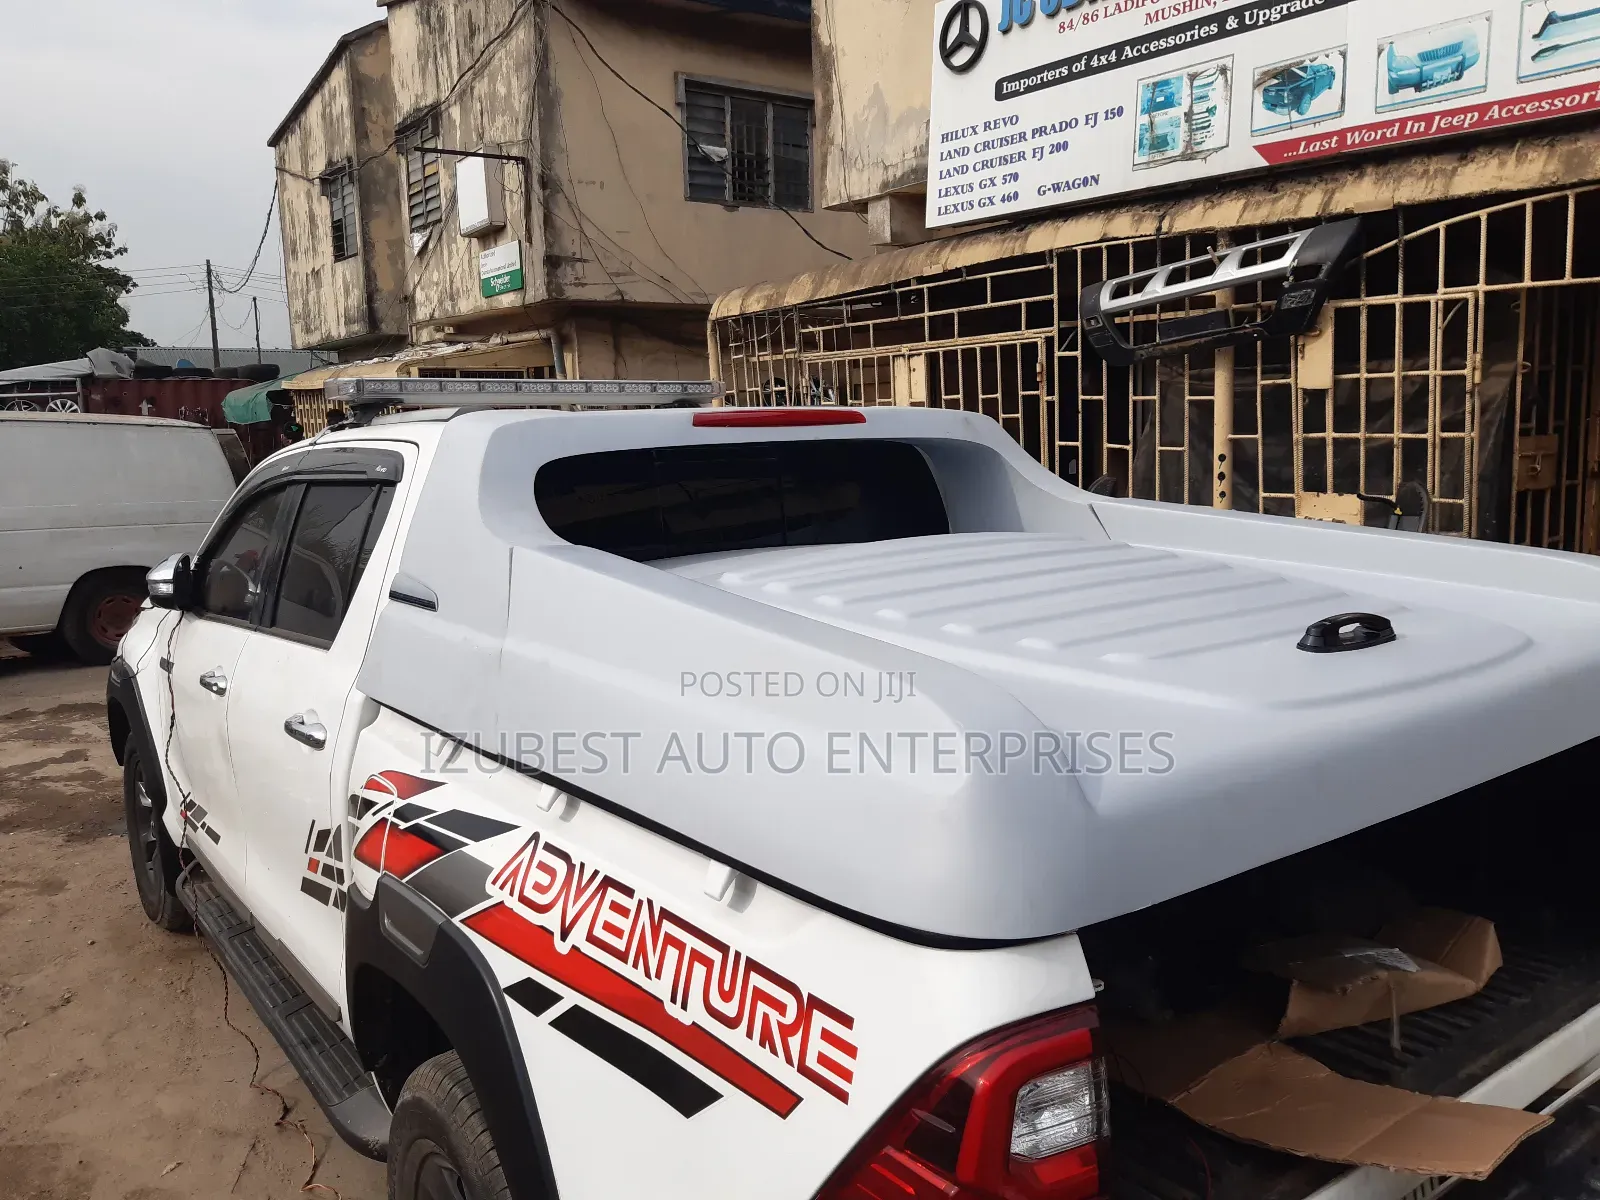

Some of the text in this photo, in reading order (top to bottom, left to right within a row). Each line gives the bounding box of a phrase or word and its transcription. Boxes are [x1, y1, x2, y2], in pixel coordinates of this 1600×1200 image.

[1058, 9, 1099, 34] 84/86
[1001, 66, 1069, 95] Importers
[1072, 56, 1088, 72] of
[1090, 48, 1118, 69] 4x4
[1121, 22, 1219, 60] Accessories
[1225, 15, 1240, 30] &
[939, 105, 1125, 162] LAND CRUISER PRADO FJ 150
[940, 114, 1020, 144] HILUX REVO
[1283, 135, 1339, 158] ...Last
[1346, 122, 1401, 146] Word
[1404, 119, 1426, 135] In
[1428, 110, 1479, 137] Jeep
[939, 140, 1069, 181] LAND CRUISER FJ 200
[937, 171, 1020, 199] LEXUS GX 570
[1037, 174, 1101, 197] G-WAGON
[937, 190, 1020, 217] LEXUS GX 460
[491, 832, 859, 1106] ADVENTURE
